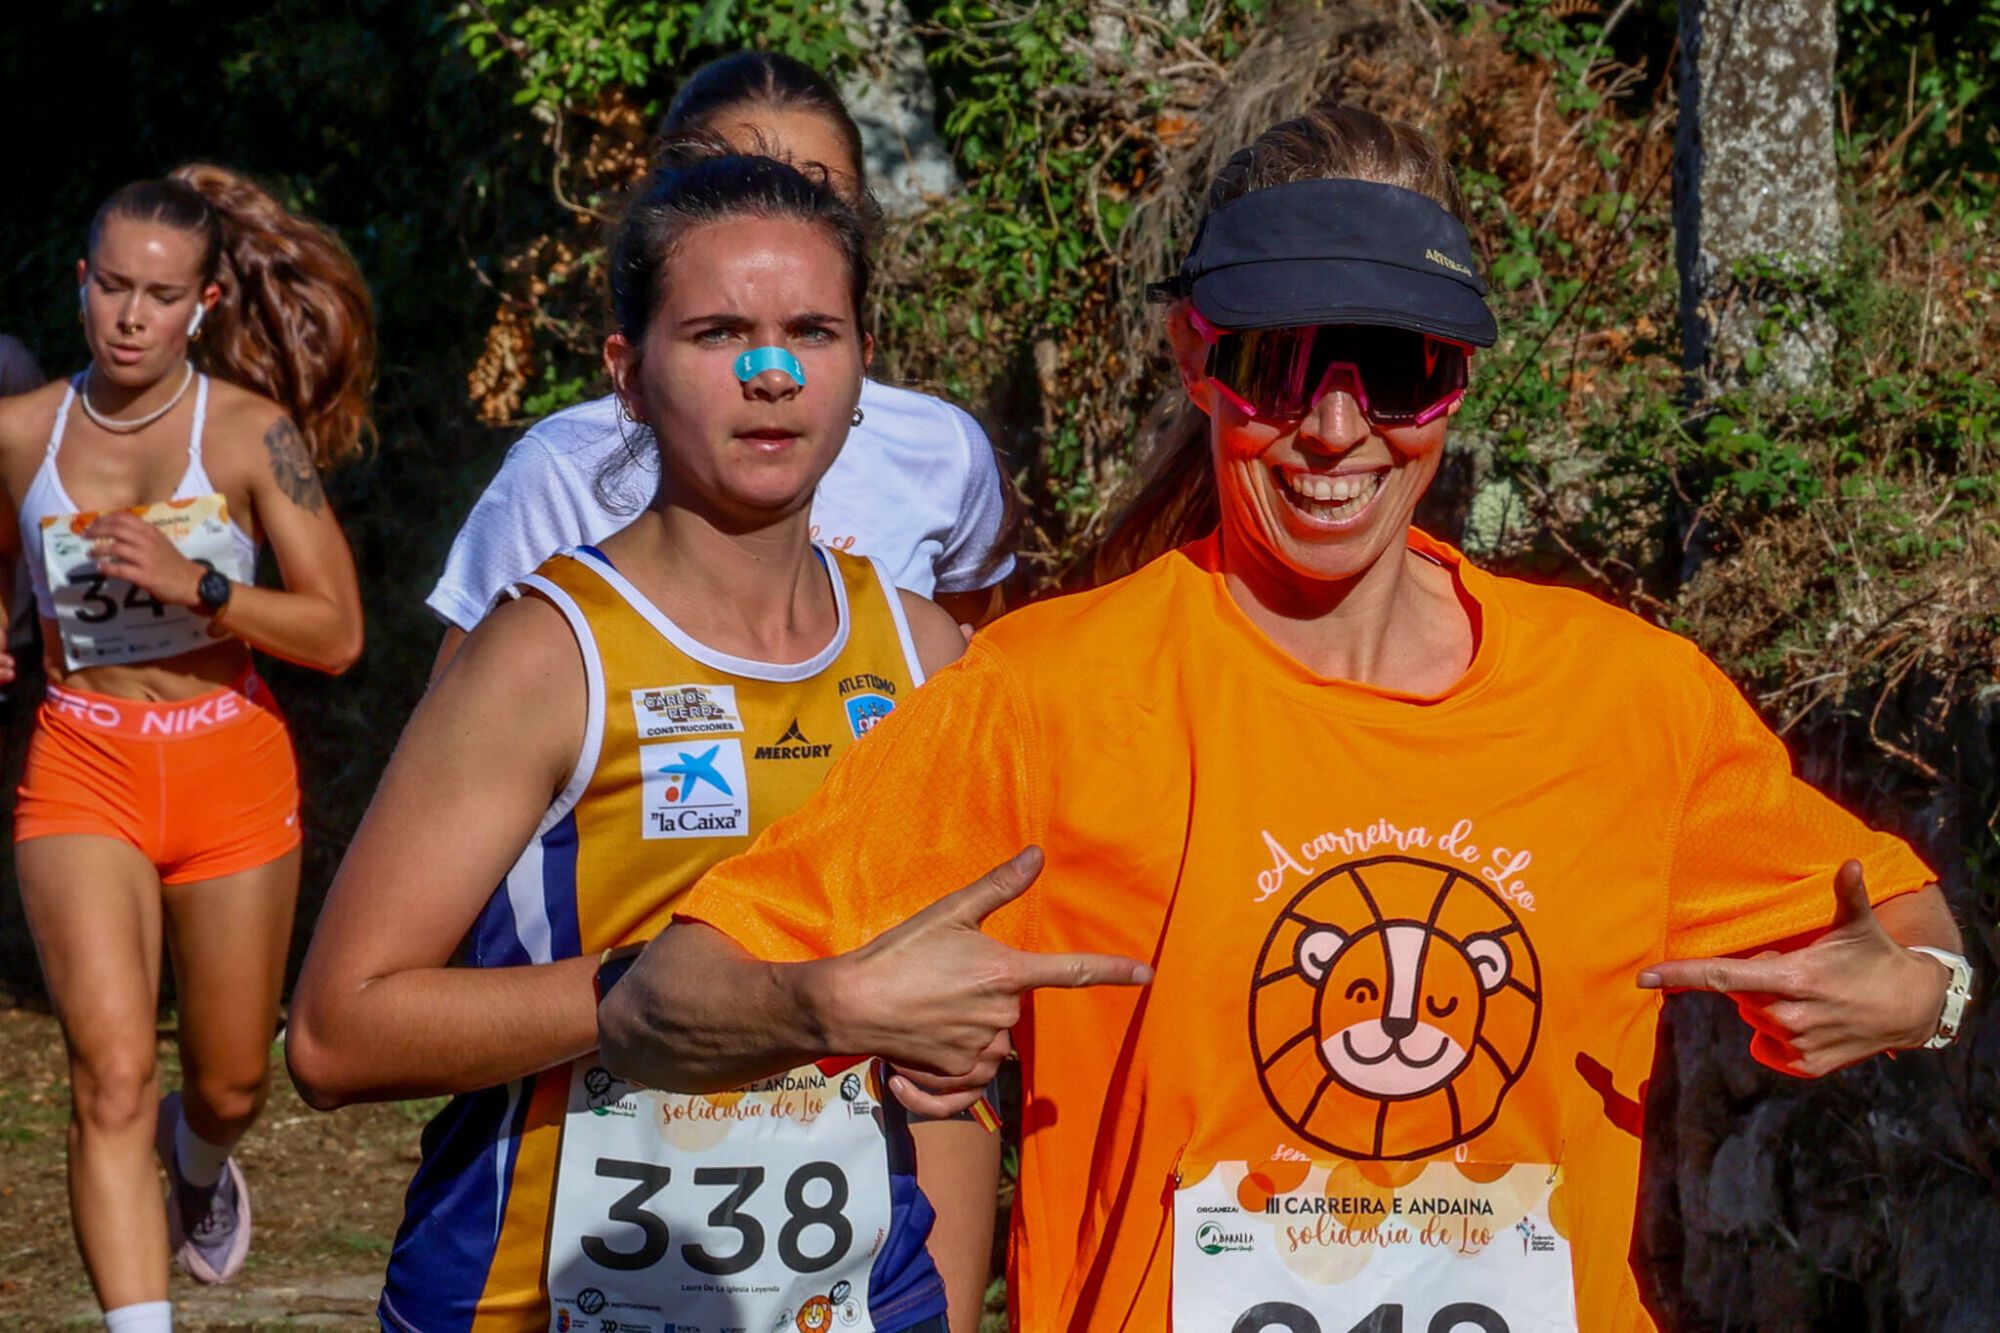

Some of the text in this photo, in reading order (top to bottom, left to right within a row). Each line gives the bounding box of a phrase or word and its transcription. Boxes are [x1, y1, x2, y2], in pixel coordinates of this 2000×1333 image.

[837, 673, 896, 697] ATLETISMO
[644, 690, 708, 710] CARLOS
[141, 690, 240, 735] NIKE
[647, 722, 735, 736] CONSTRUCCIONES
[754, 743, 833, 760] MERCURY
[1253, 817, 1537, 912] A carreira de Leo
[765, 1074, 827, 1093] ANDAINA
[662, 1092, 764, 1125] solidaria
[769, 1092, 793, 1120] de
[800, 1091, 827, 1122] Leo
[580, 1157, 853, 1276] 338
[1265, 1196, 1494, 1216] III CARREIRA E ANDAINA
[1286, 1212, 1413, 1253] solidaria
[1419, 1214, 1451, 1247] de
[1457, 1216, 1495, 1255] Leo
